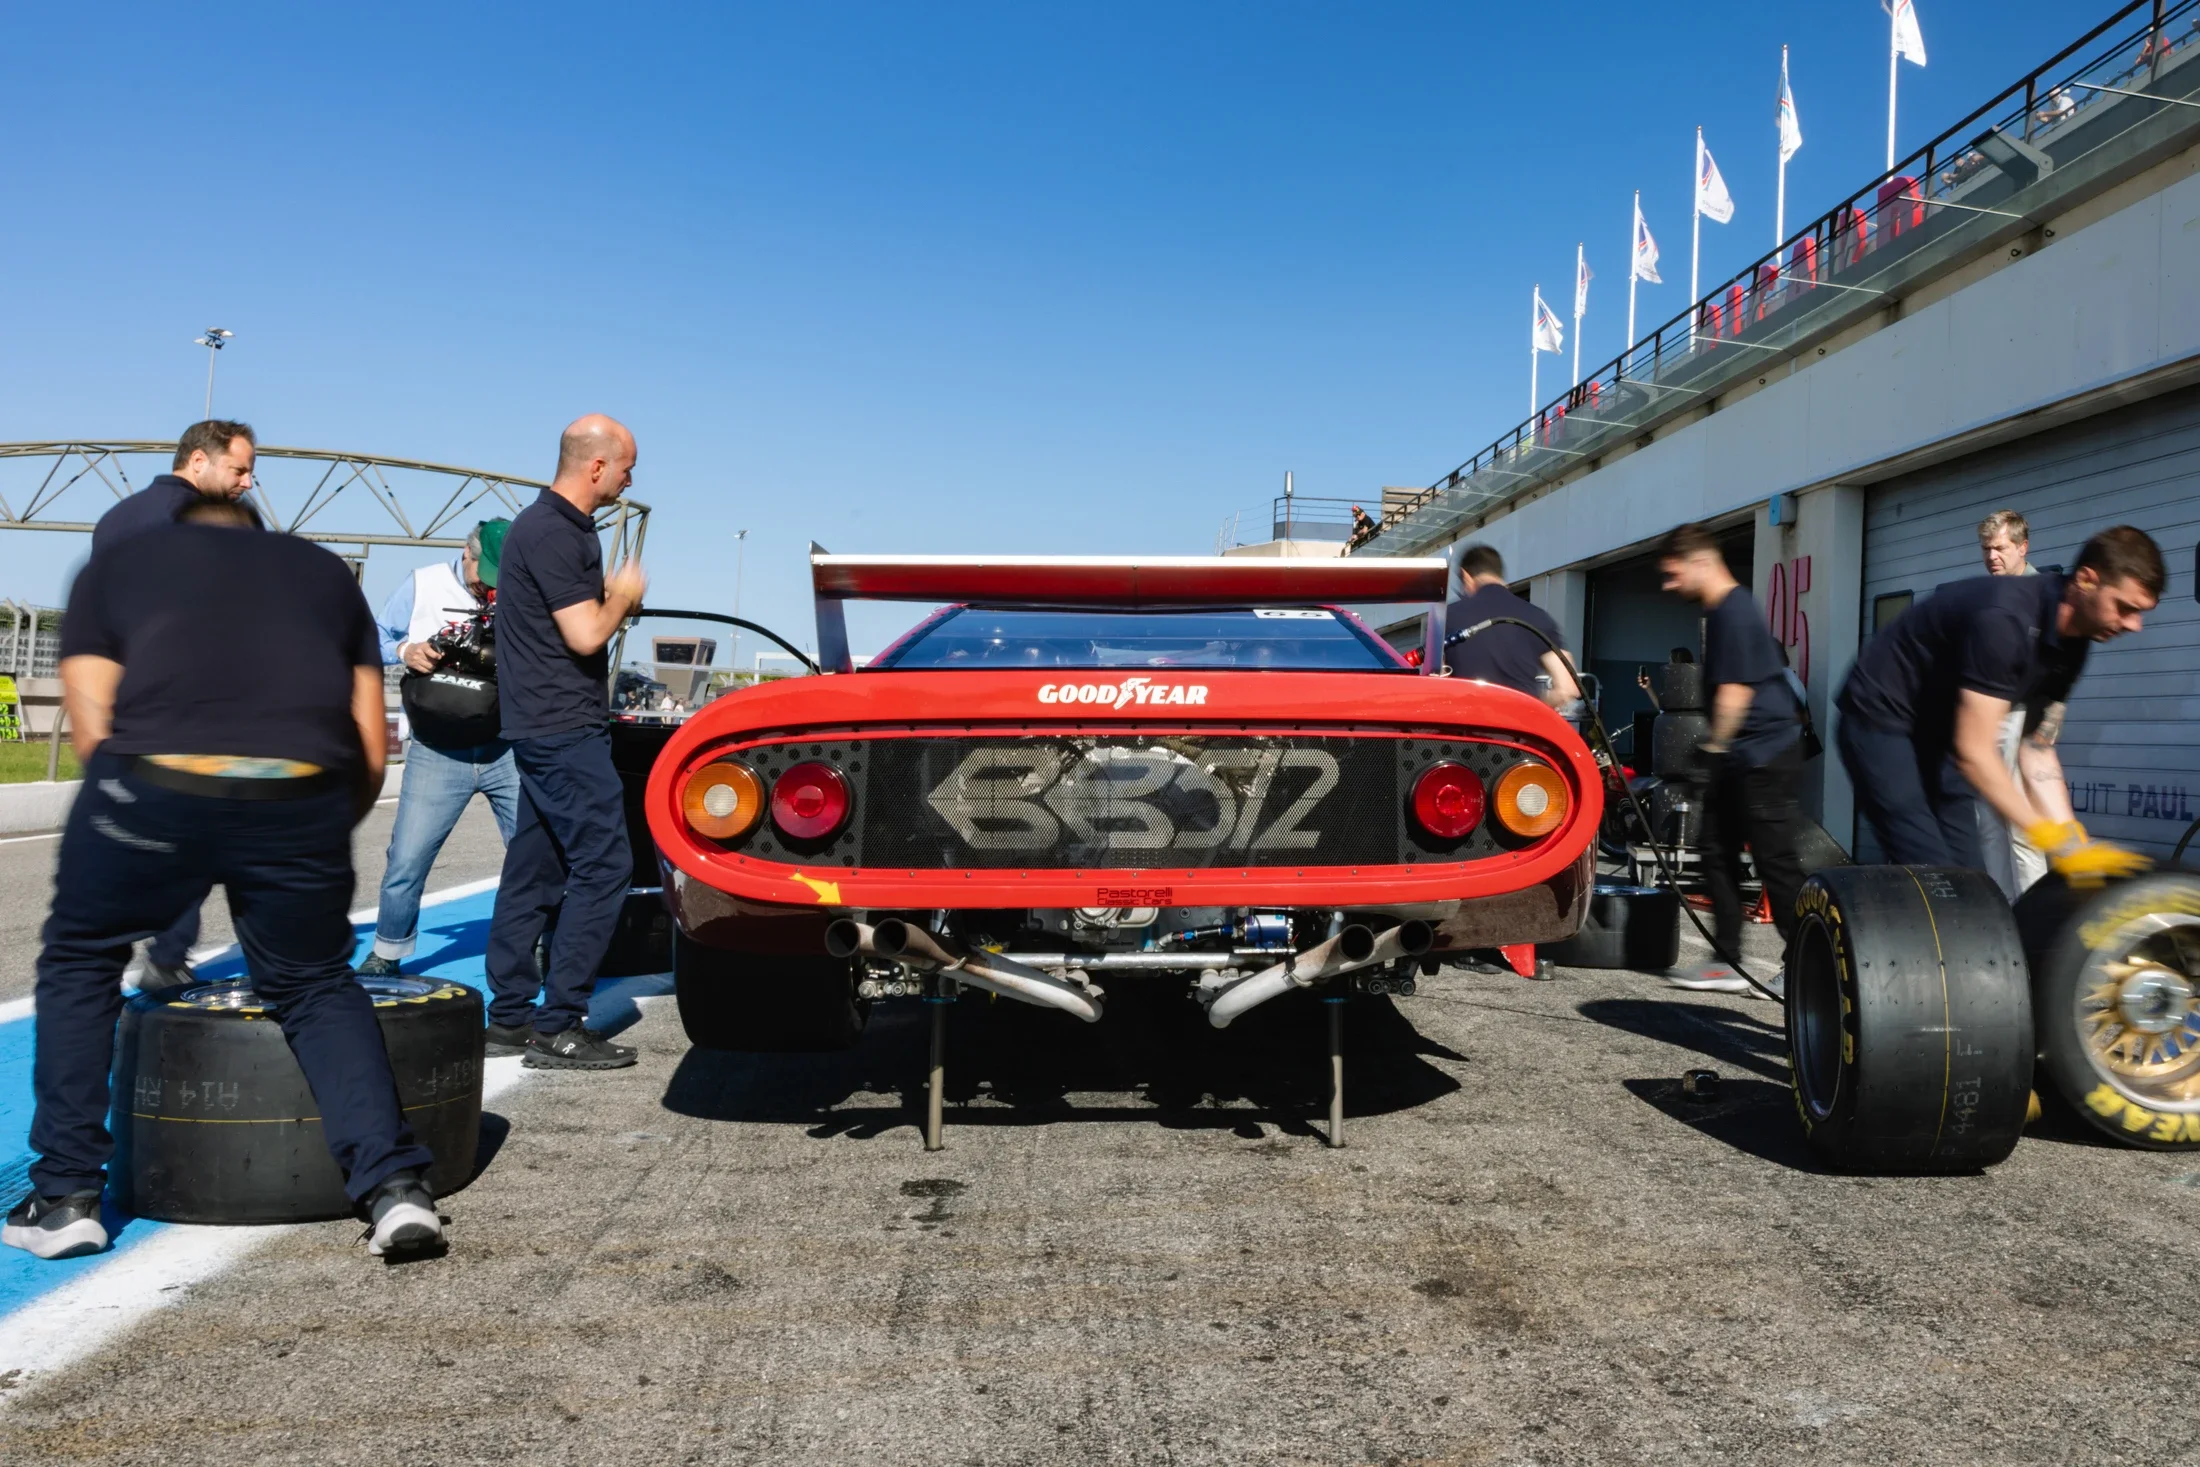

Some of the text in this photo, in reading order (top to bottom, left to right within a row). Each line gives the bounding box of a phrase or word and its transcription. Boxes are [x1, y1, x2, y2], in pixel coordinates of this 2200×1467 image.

[430, 673, 486, 691] SAKK
[1038, 680, 1208, 708] GOODYEAR
[2067, 782, 2193, 820] UIT PAUL
[1097, 887, 1173, 898] Pastorelli
[1097, 898, 1173, 906] Classic Cars
